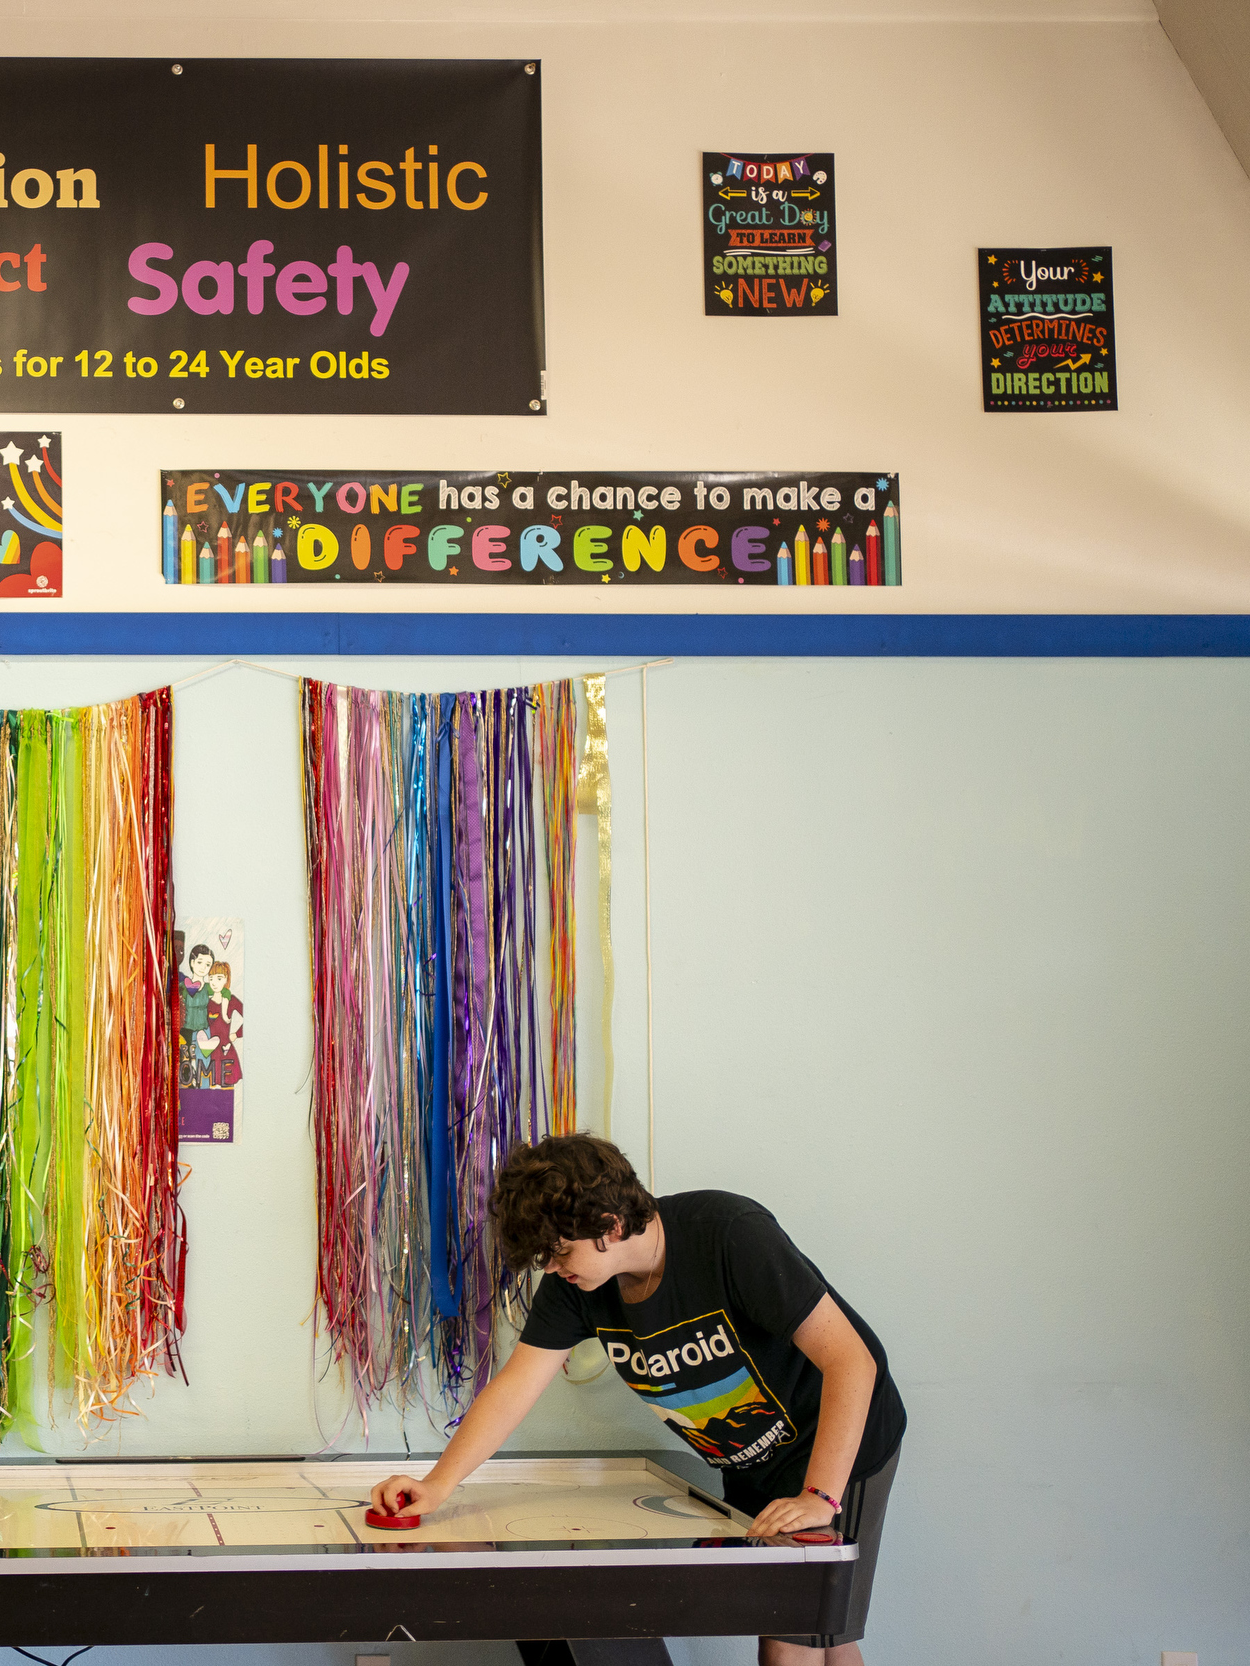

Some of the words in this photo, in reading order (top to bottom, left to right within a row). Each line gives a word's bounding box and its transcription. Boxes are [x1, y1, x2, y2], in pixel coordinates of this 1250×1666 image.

[205, 143, 488, 210] Holistic
[731, 159, 805, 179] TODAY
[751, 186, 770, 204] is
[771, 190, 787, 202] a
[708, 203, 773, 234] Great
[736, 232, 756, 244] TO
[760, 232, 807, 244] LEARN
[712, 255, 828, 275] SOMETHING
[1020, 260, 1075, 290] Your
[127, 239, 410, 337] Safety
[737, 278, 809, 308] NEW
[987, 293, 1106, 313] ATTITUDE
[989, 319, 1107, 349] DETERMINES
[13, 349, 63, 378] for
[75, 350, 114, 378] 12
[124, 350, 158, 378] to
[168, 350, 209, 378] 24
[219, 350, 299, 379] Year
[310, 350, 390, 379] Olds
[1016, 342, 1077, 369] your
[991, 371, 1109, 394] DIRECTION
[186, 481, 424, 514] EVERYONE
[439, 479, 500, 510] has
[512, 486, 533, 510] a
[547, 480, 682, 511] chance
[694, 480, 731, 511] to
[743, 481, 842, 512] make
[854, 486, 876, 511] a
[297, 523, 772, 572] DIFFERENCE
[607, 1324, 735, 1378] Poaroid
[730, 1420, 784, 1463] REMEMBER
